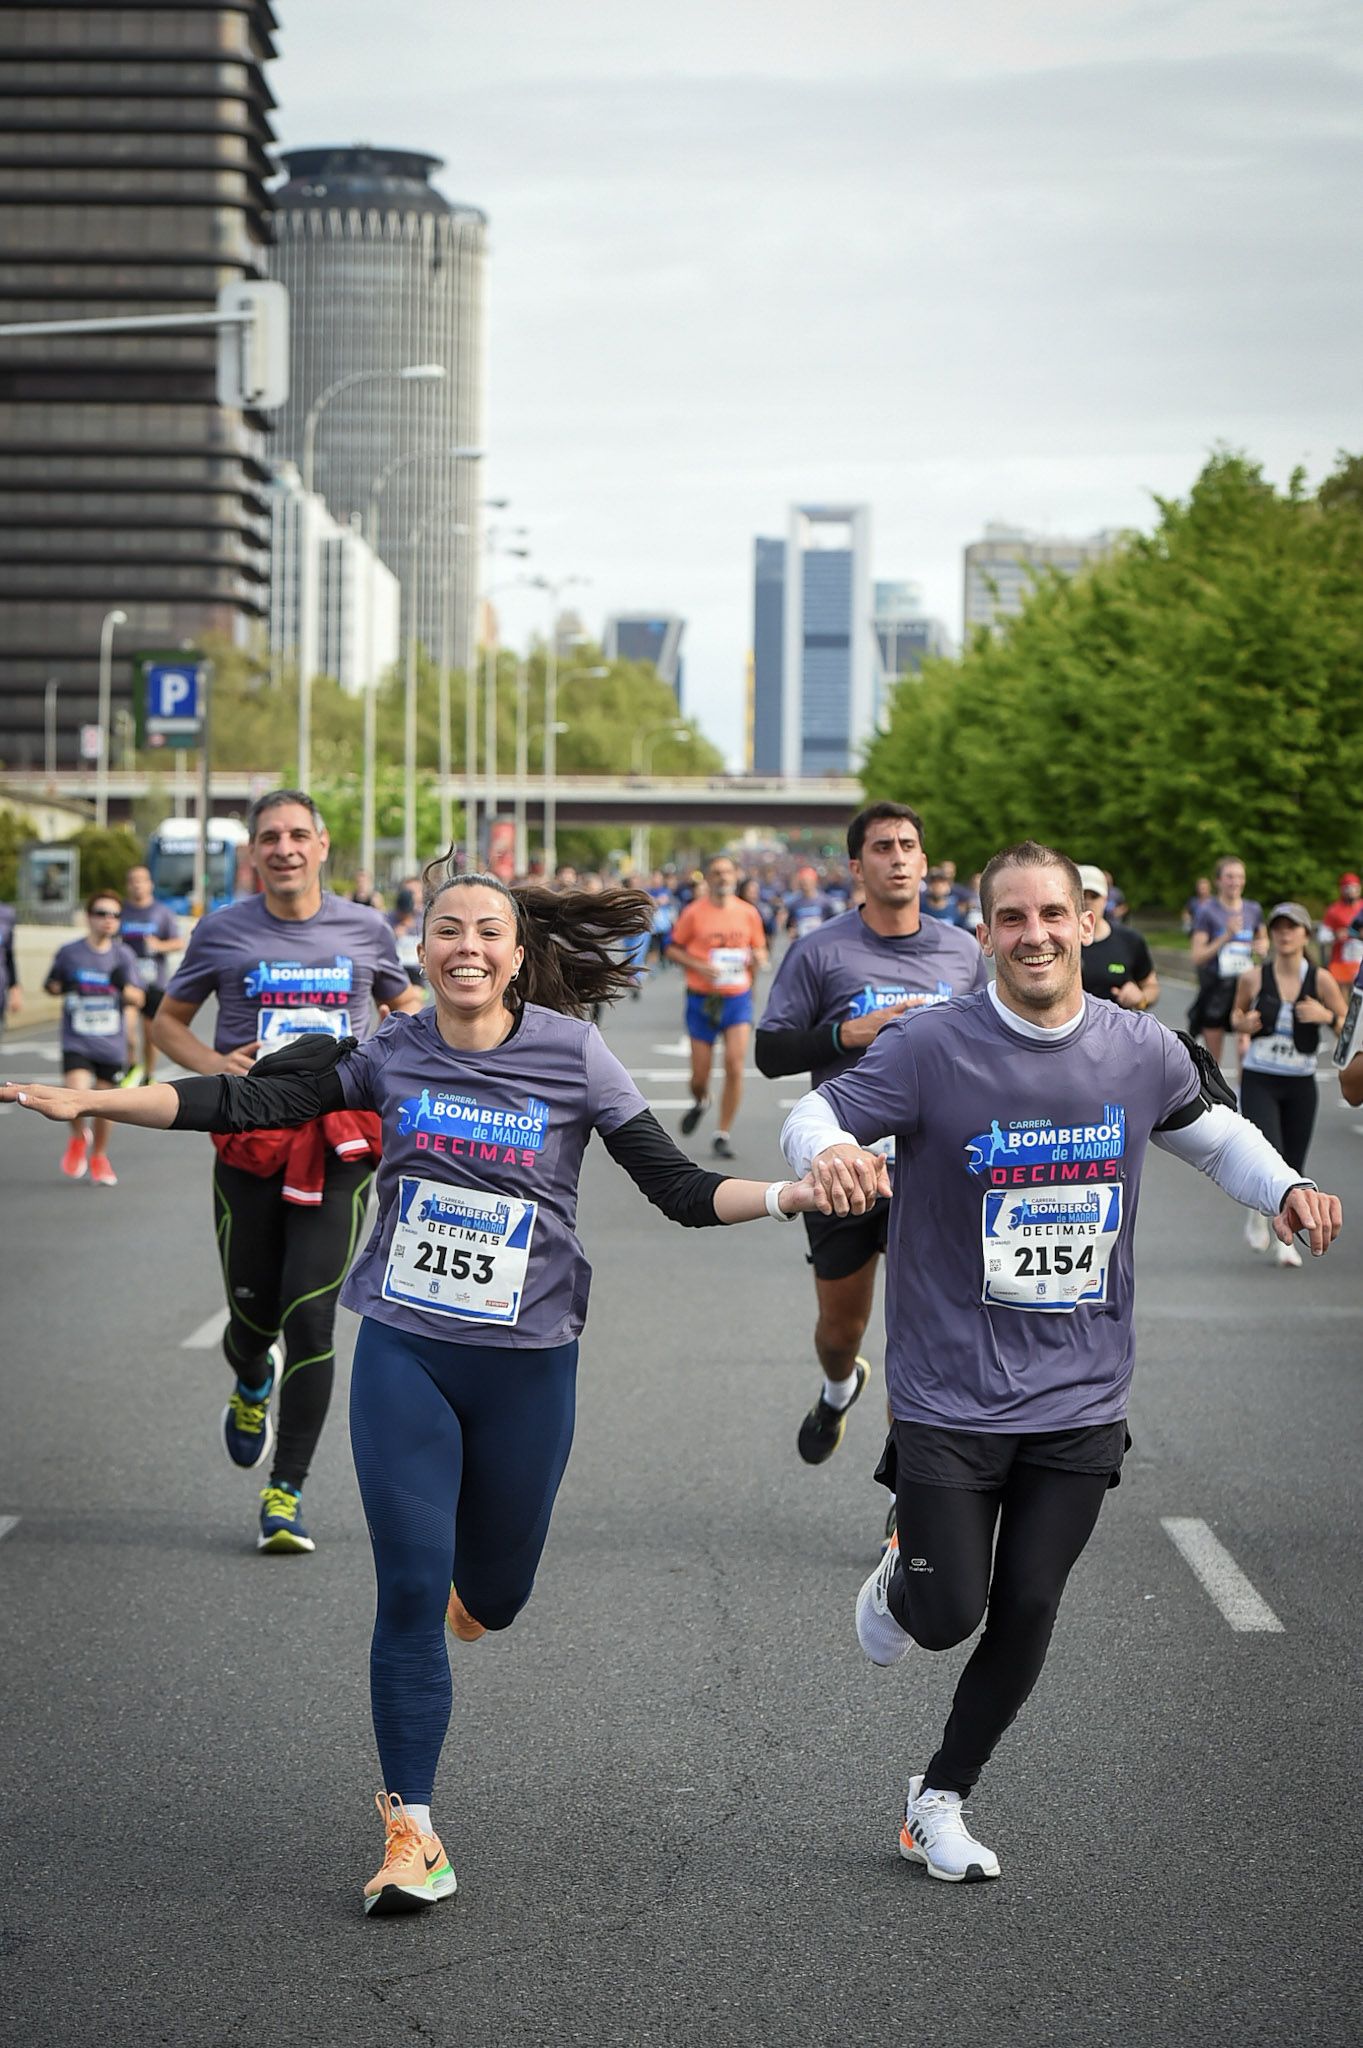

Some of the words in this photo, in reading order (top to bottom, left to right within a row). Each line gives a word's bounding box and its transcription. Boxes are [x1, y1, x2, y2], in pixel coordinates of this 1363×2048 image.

[160, 673, 190, 716] P
[271, 967, 350, 981] BOMBEROS
[261, 992, 348, 1005] DECIMAS
[437, 1092, 478, 1105] CARRERA
[432, 1101, 543, 1132] BOMBEROS
[1009, 1118, 1053, 1129] CARRERA
[472, 1126, 489, 1139] de
[491, 1128, 541, 1148] MADRID
[1008, 1124, 1121, 1148] BOMBEROS
[415, 1132, 536, 1168] DECIMAS
[1051, 1147, 1068, 1161] de
[1072, 1140, 1121, 1160] MADRID
[992, 1160, 1117, 1184] DECIMAS
[440, 1195, 466, 1205] CARRERA
[1031, 1203, 1097, 1213] BOMBEROS
[438, 1202, 507, 1225] BOMBEROS
[1056, 1215, 1067, 1223] de
[1068, 1212, 1099, 1223] MADRID
[427, 1222, 501, 1246] DECIMAS
[461, 1218, 472, 1227] de
[473, 1219, 505, 1234] MADRID
[1023, 1225, 1096, 1236] DECIMAS
[413, 1241, 496, 1285] 2153
[1014, 1245, 1094, 1278] 2154
